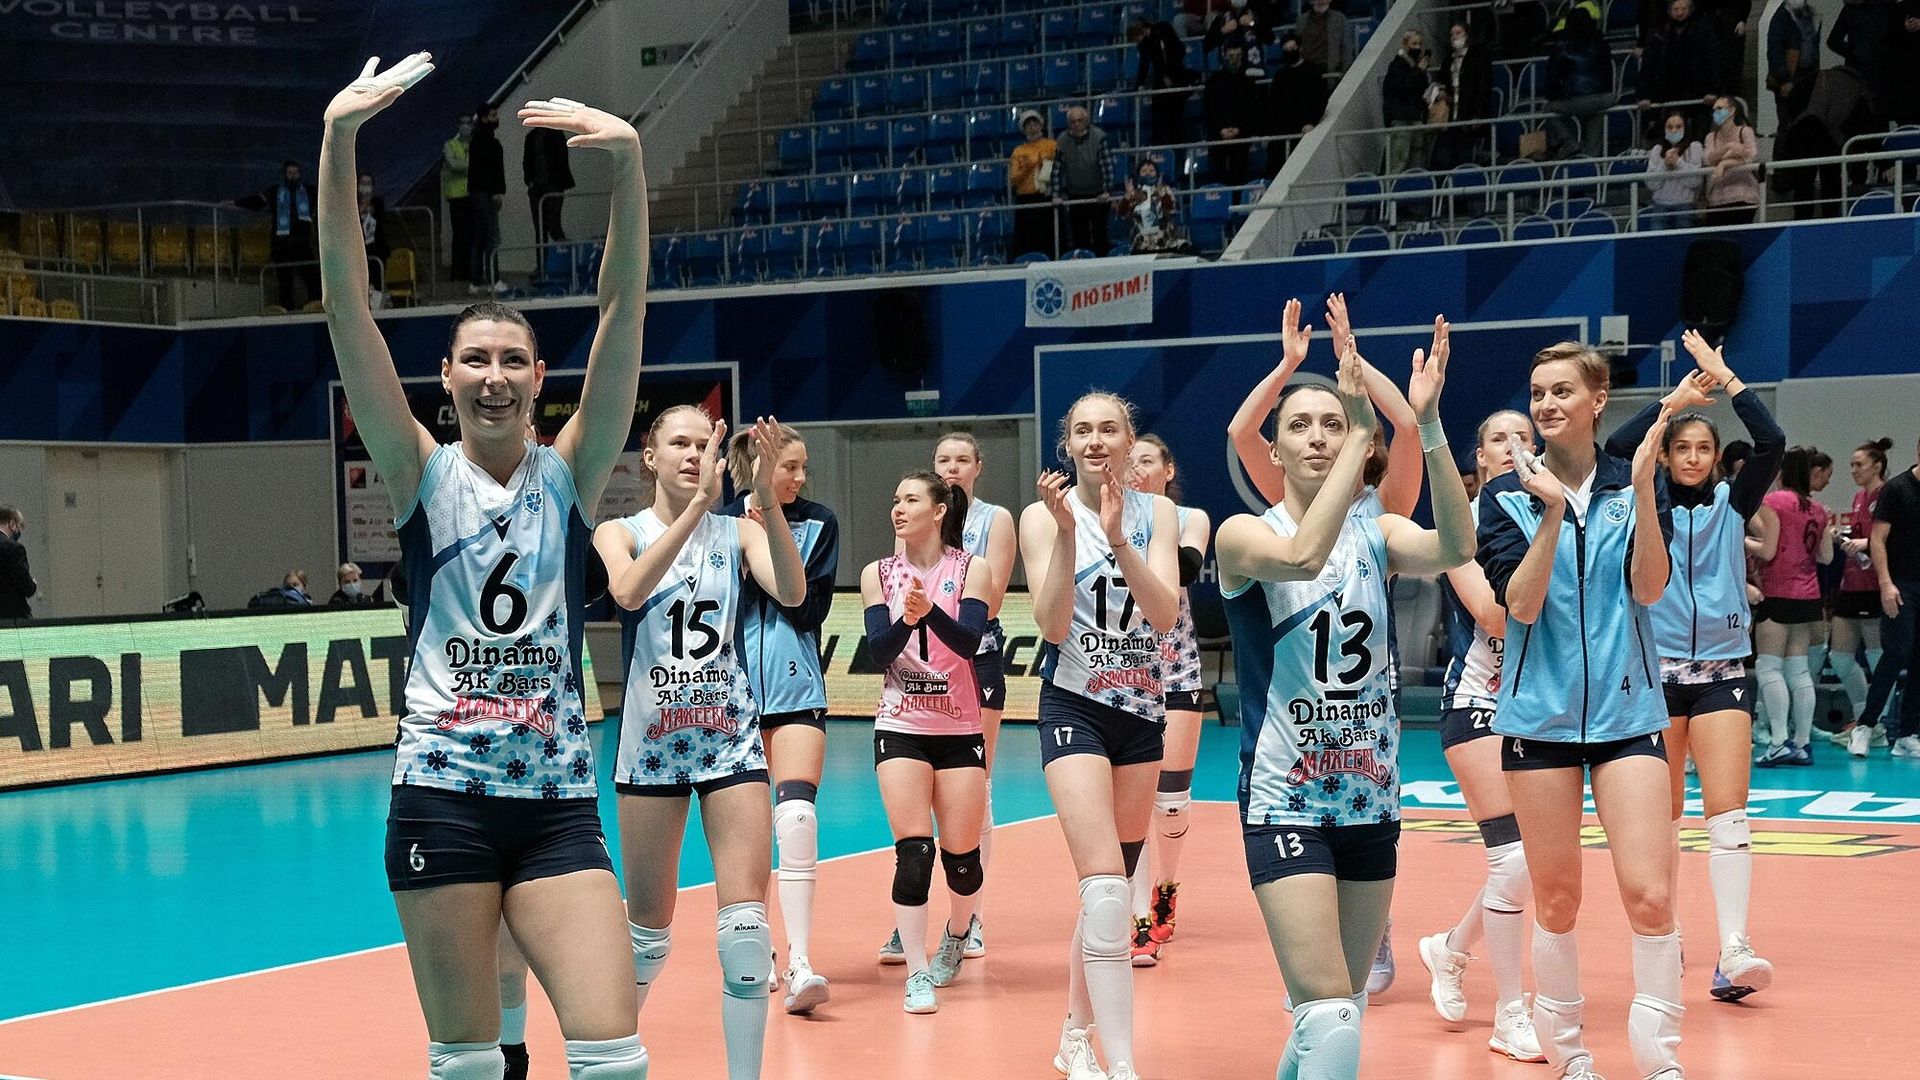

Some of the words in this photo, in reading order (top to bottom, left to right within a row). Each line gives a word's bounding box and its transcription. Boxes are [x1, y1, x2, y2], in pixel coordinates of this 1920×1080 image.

[50, 21, 257, 43] CENTRE
[1072, 273, 1149, 311] ЛЮБИМ!
[479, 551, 528, 635] 6
[1090, 574, 1136, 632] 17
[666, 599, 721, 660] 15
[1726, 613, 1741, 629] 12
[446, 637, 558, 668] Dinamo
[1080, 632, 1154, 653] Dinamo
[1310, 609, 1374, 685] 13
[789, 661, 798, 676] 3
[1089, 654, 1114, 668] Ak
[1120, 653, 1151, 667] Bars
[451, 671, 489, 693] Ak
[497, 672, 551, 694] Bars
[650, 666, 729, 688] Dinamo
[906, 683, 921, 692] Ak
[924, 682, 947, 693] Bars
[1620, 675, 1631, 696] 4
[656, 690, 683, 705] Ak
[690, 689, 728, 706] Bars
[1289, 698, 1382, 725] Dinamo
[879, 738, 886, 754] 1
[1053, 727, 1074, 746] 17
[1297, 728, 1332, 747] Ak
[1339, 728, 1377, 747] Bars
[1512, 739, 1524, 758] 4
[409, 843, 425, 871] 6
[1274, 833, 1304, 859] 13
